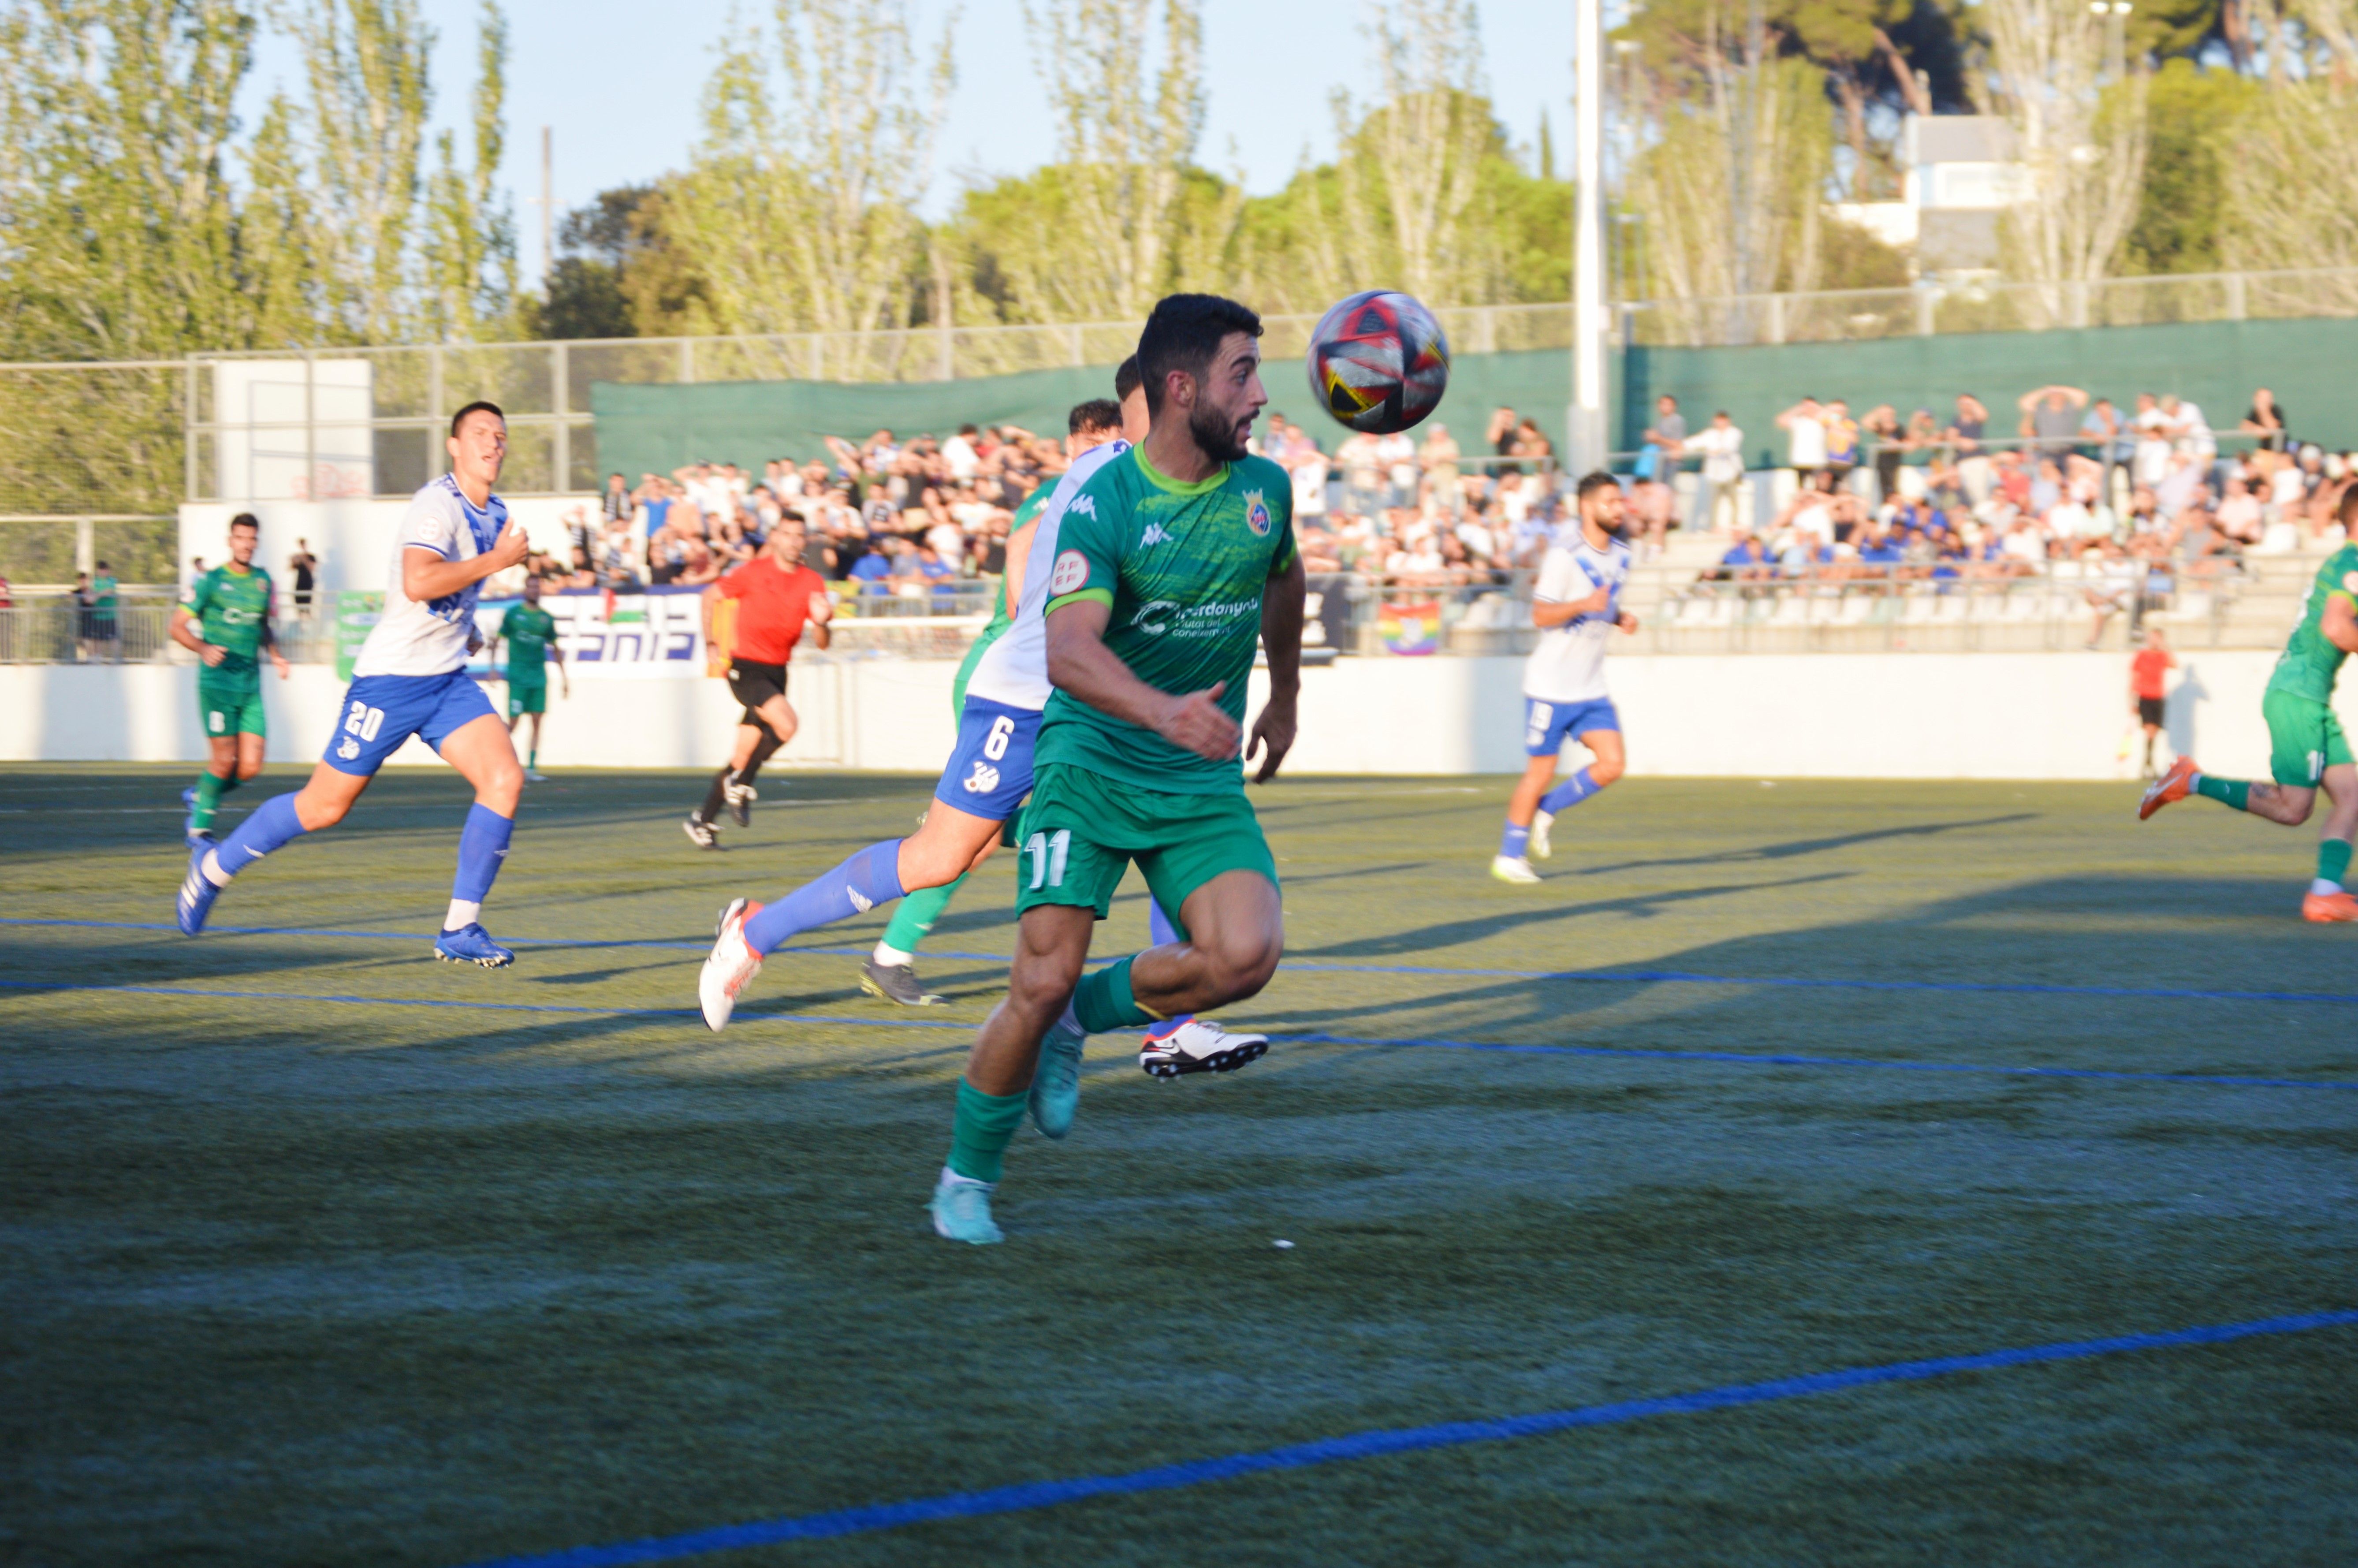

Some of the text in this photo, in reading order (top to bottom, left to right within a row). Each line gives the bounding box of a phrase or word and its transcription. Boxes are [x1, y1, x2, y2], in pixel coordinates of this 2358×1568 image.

[344, 700, 385, 742] 20
[984, 715, 1015, 761] 6
[1024, 829, 1071, 889] 11
